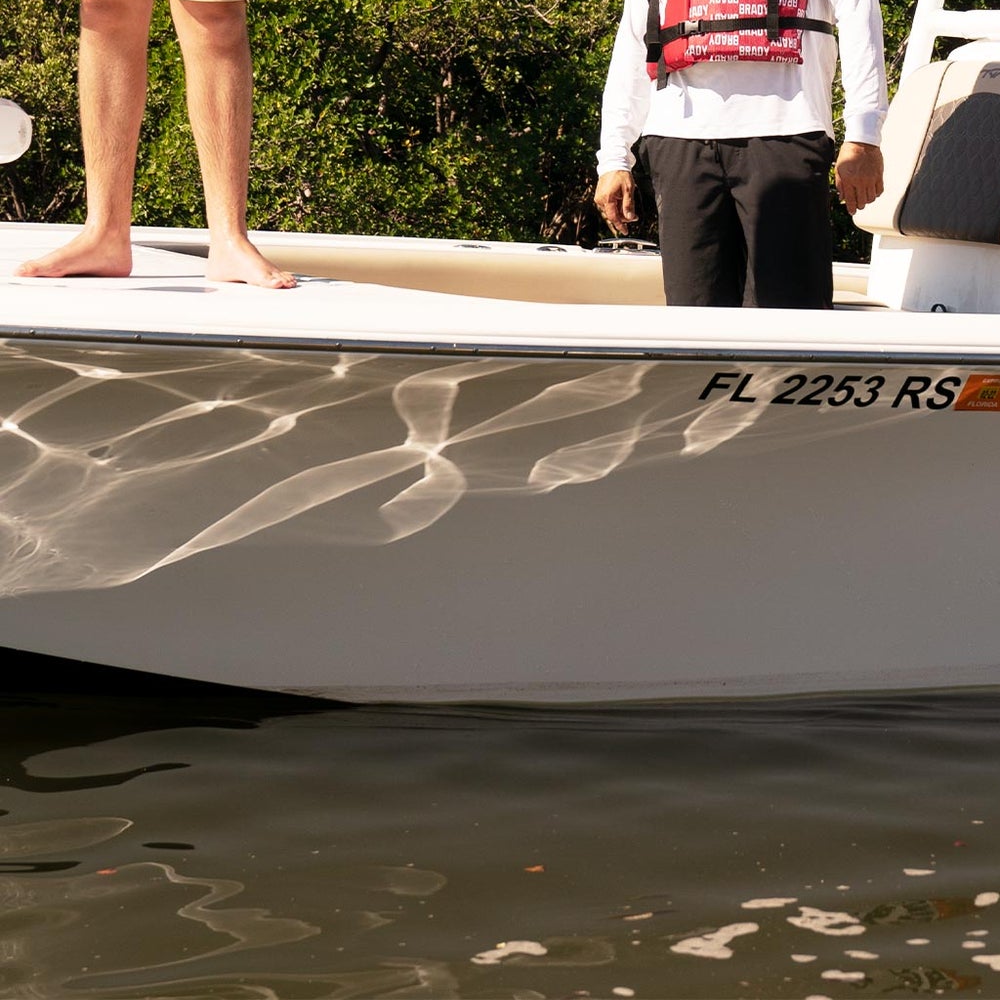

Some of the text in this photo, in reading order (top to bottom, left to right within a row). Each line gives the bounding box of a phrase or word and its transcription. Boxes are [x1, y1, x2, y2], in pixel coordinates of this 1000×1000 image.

[739, 3, 768, 16] BRADY
[708, 34, 739, 46] BRADY
[739, 46, 770, 57] BRADY
[698, 372, 961, 410] FL 2253 RS
